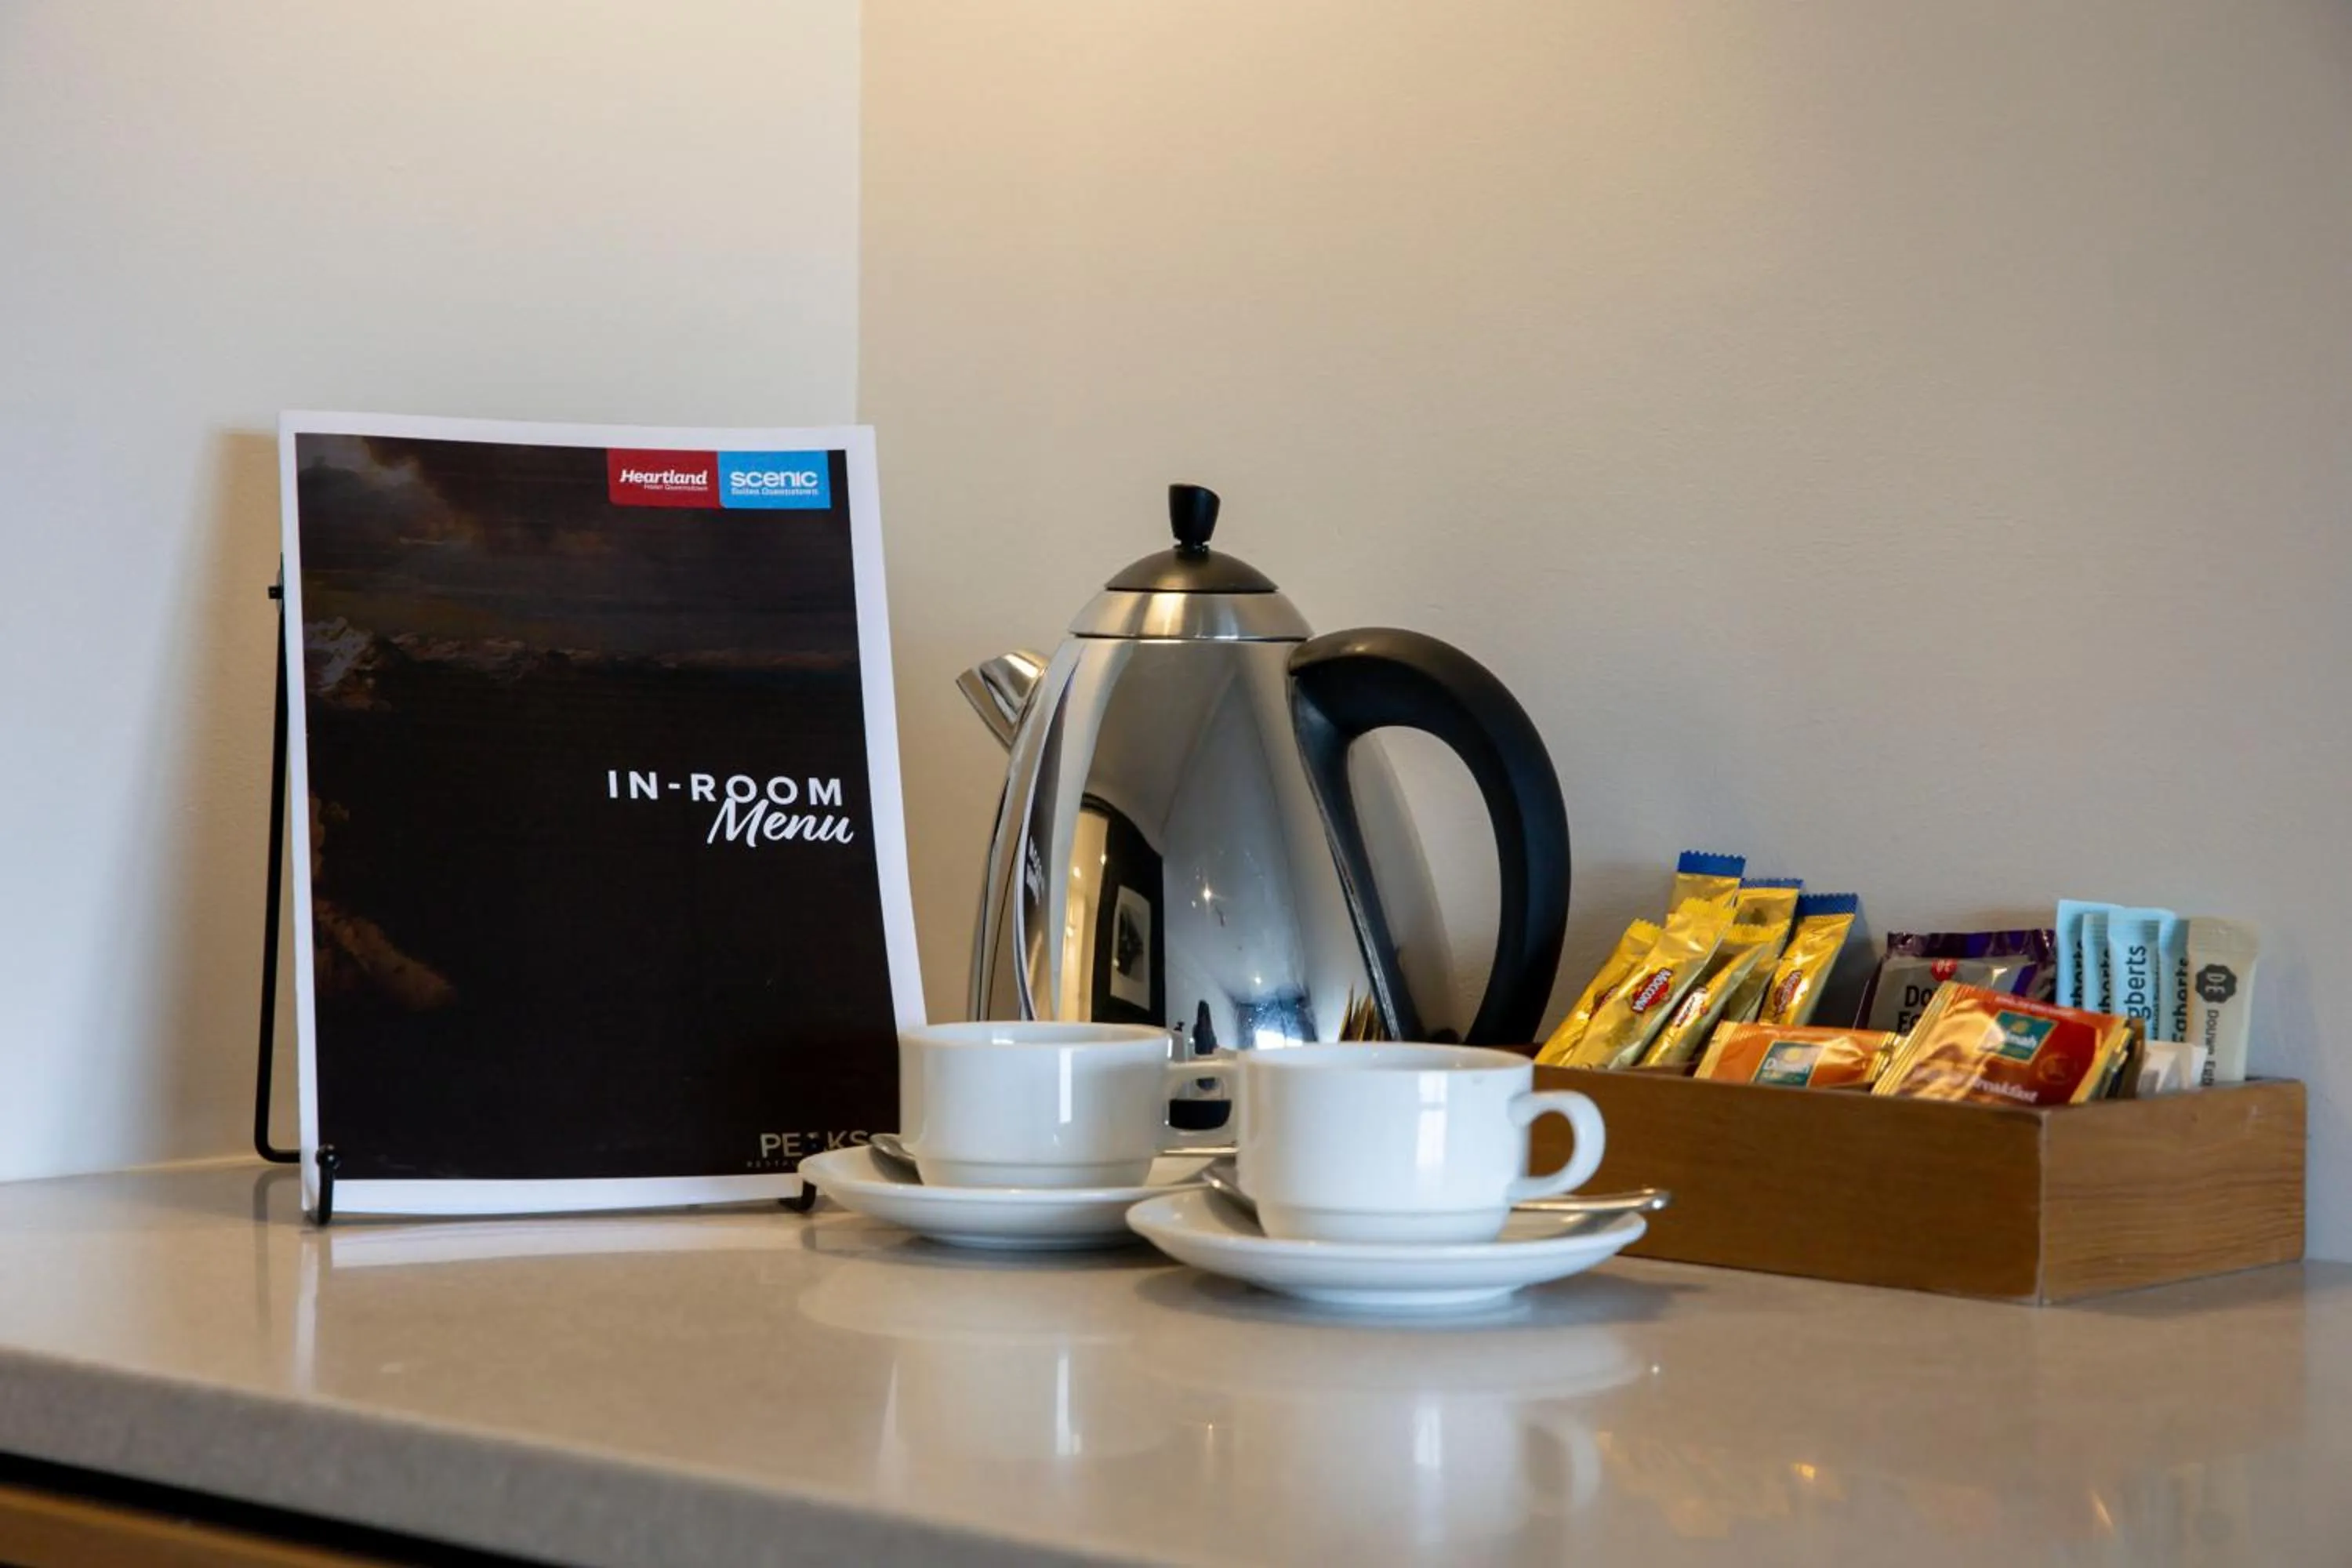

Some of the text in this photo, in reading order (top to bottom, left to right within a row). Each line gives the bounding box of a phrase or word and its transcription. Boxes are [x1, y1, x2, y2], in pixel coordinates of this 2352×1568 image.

[619, 469, 708, 485] Heartland
[730, 470, 818, 488] scenic
[608, 770, 843, 806] IN-ROOM
[706, 797, 855, 848] Menu
[2124, 945, 2151, 1020] gberts
[2205, 973, 2227, 994] DE
[760, 1130, 868, 1159] PEKS
